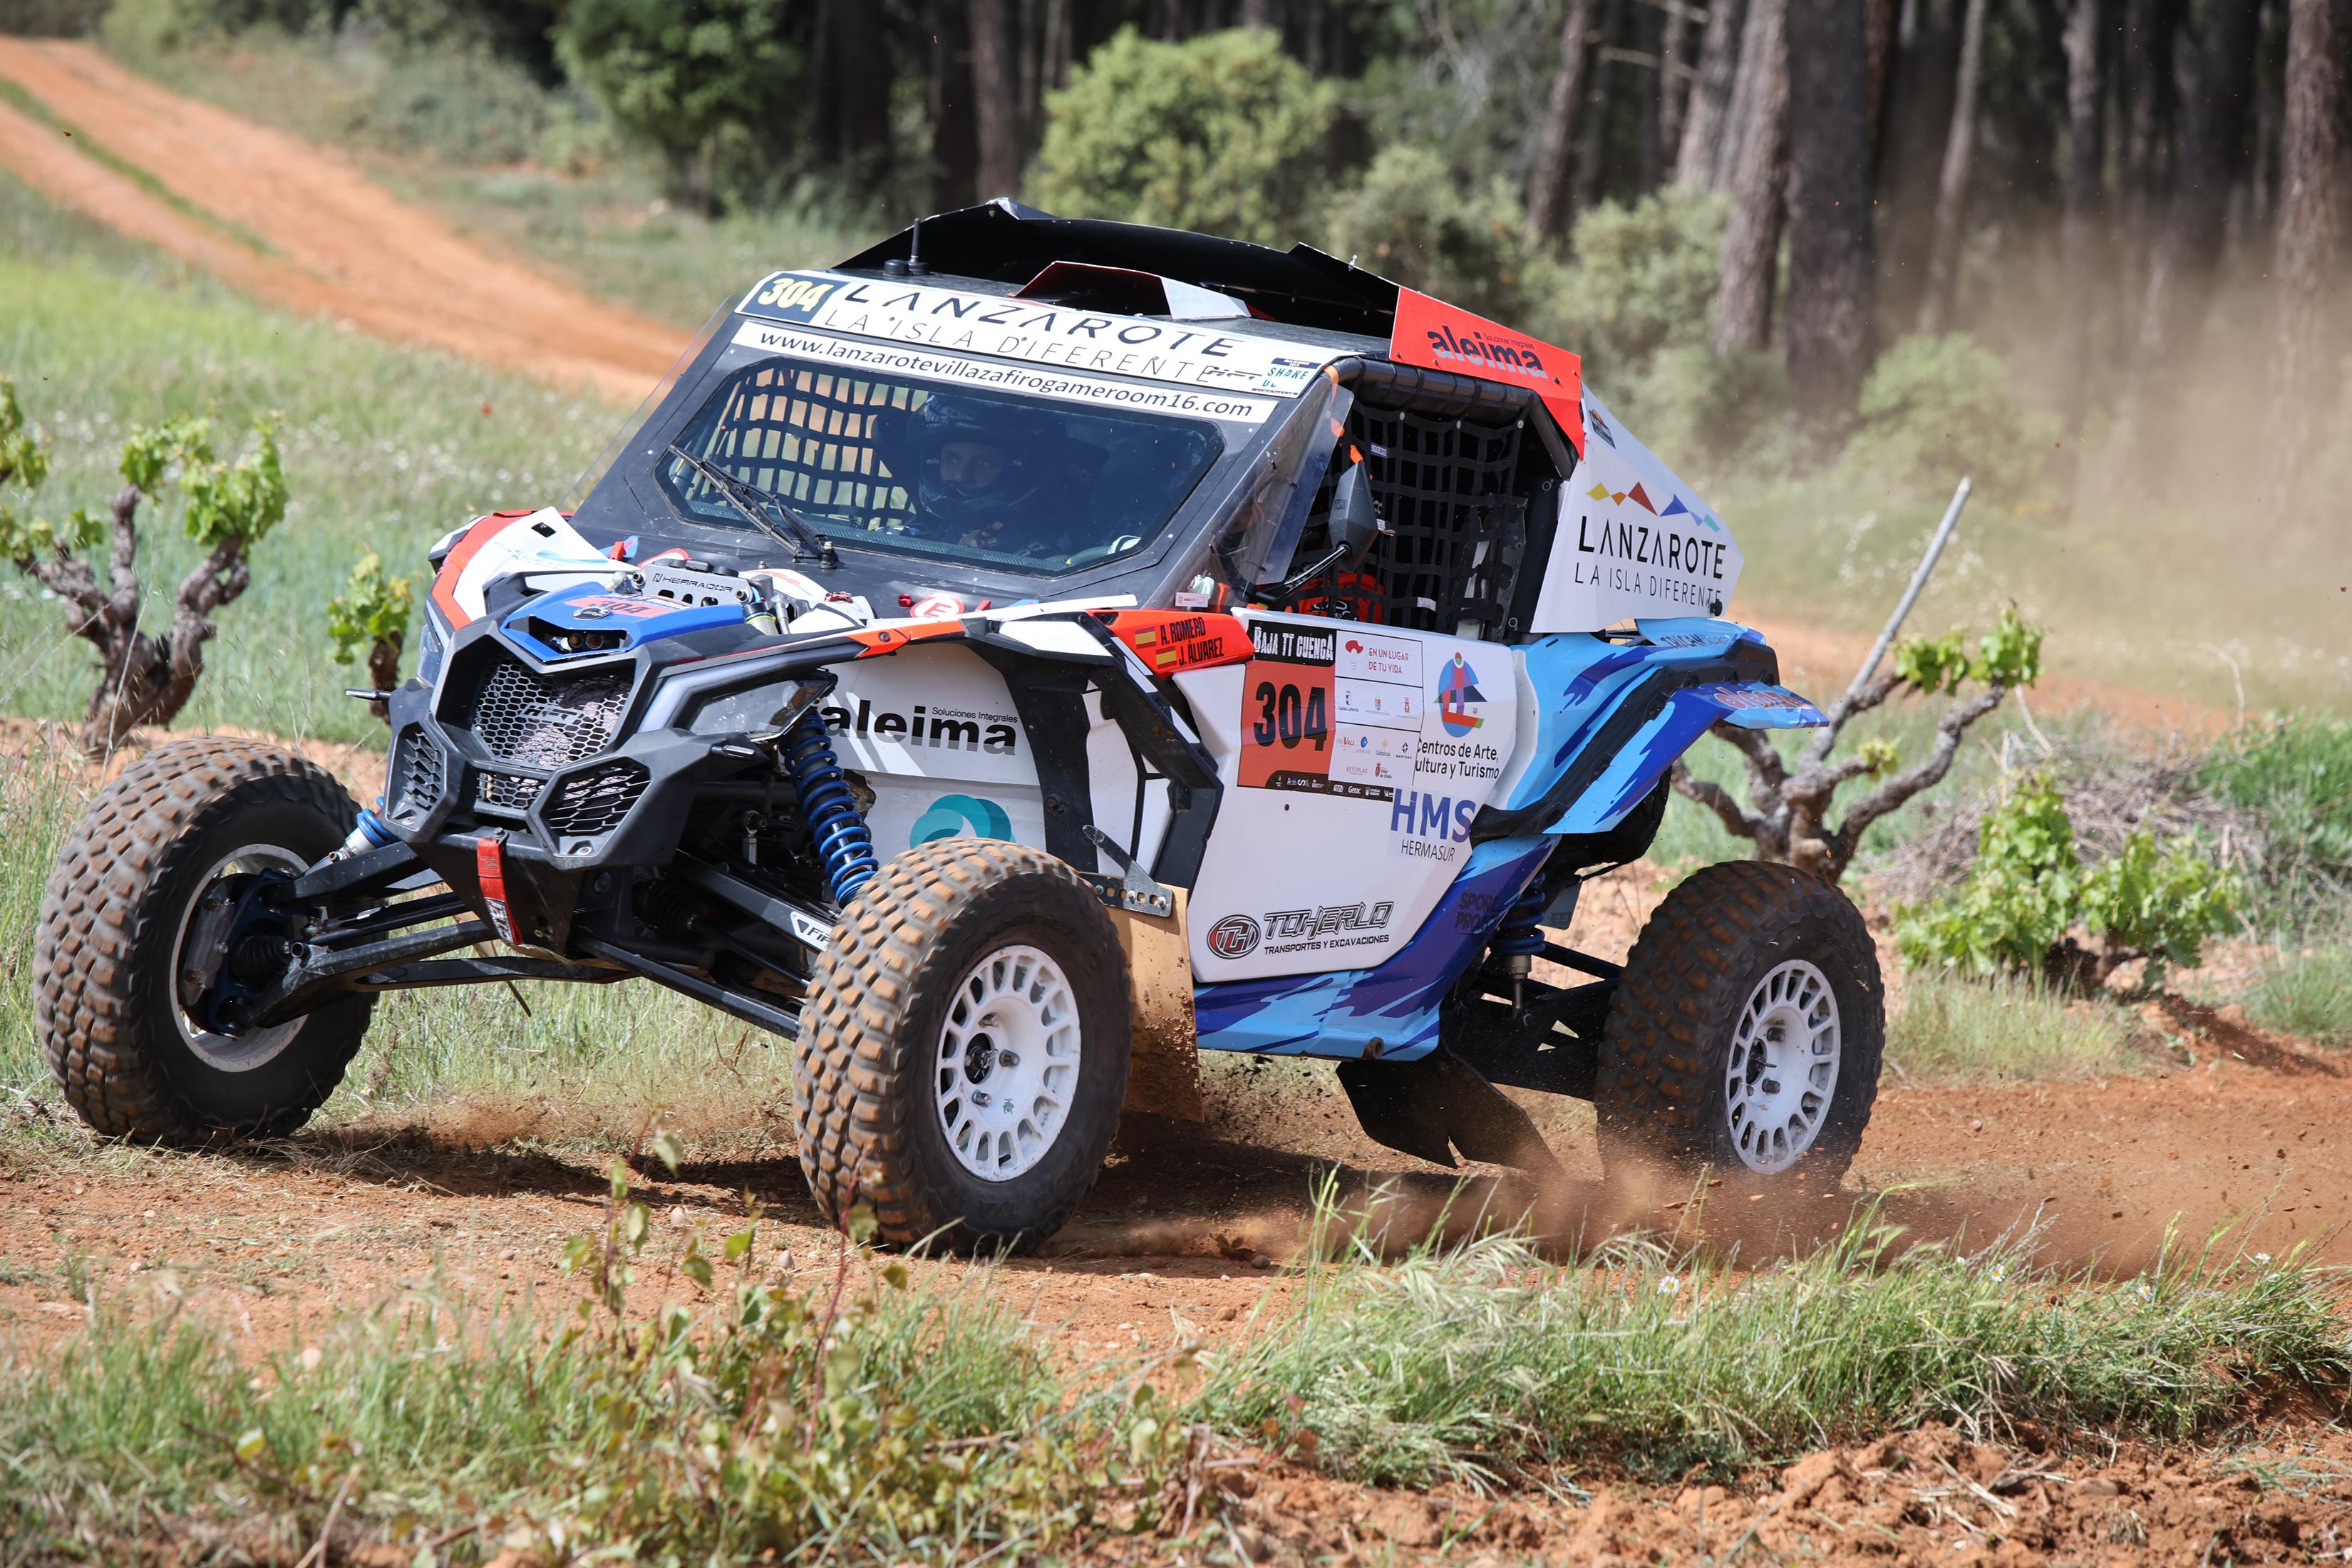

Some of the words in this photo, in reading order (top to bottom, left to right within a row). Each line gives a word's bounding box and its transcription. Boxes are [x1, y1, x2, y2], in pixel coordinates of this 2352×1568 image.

[758, 278, 834, 312] 304
[845, 284, 1245, 357] LANZAROTE
[825, 309, 868, 331] LA
[889, 319, 973, 348] ISLA
[998, 336, 1214, 383] DIFERENTE
[1427, 325, 1548, 379] aleima
[760, 332, 1252, 416] www.lanzarotevillazafirogameroom16.com
[1267, 367, 1309, 380] SHAKE
[1578, 515, 1727, 579] LANZAROTE
[662, 575, 733, 593] HERRADOR
[1574, 562, 1600, 586] LA
[1609, 567, 1641, 594] ISLA
[1160, 625, 1170, 646] A.
[1170, 617, 1207, 643] ROMERO
[1282, 632, 1294, 656] TT
[1296, 634, 1334, 661] CUENCA
[1179, 645, 1187, 666] J.
[1188, 636, 1224, 664] ÁLVAREZ
[1368, 647, 1377, 656] EN
[1378, 649, 1388, 658] UN
[1388, 650, 1409, 661] LUGAR
[1368, 661, 1377, 671] DE
[1378, 663, 1387, 672] TU
[1388, 664, 1403, 674] VIDA
[820, 699, 1016, 756] aleima
[932, 706, 976, 719] Soluciones
[979, 711, 1018, 723] Integrales
[1253, 681, 1328, 751] 304
[1458, 743, 1472, 758] de
[1473, 744, 1498, 763] Arte,
[1415, 757, 1448, 775] ultura
[1450, 763, 1456, 780] y
[1459, 760, 1500, 779] Turismo
[1391, 788, 1476, 843] HMS
[1401, 839, 1455, 862] HERMASUR
[1264, 901, 1395, 940] TOHERLO
[1264, 941, 1321, 955] TRANSPORTES
[1323, 941, 1329, 949] Y
[1330, 934, 1390, 949] EXCAVACIONES
